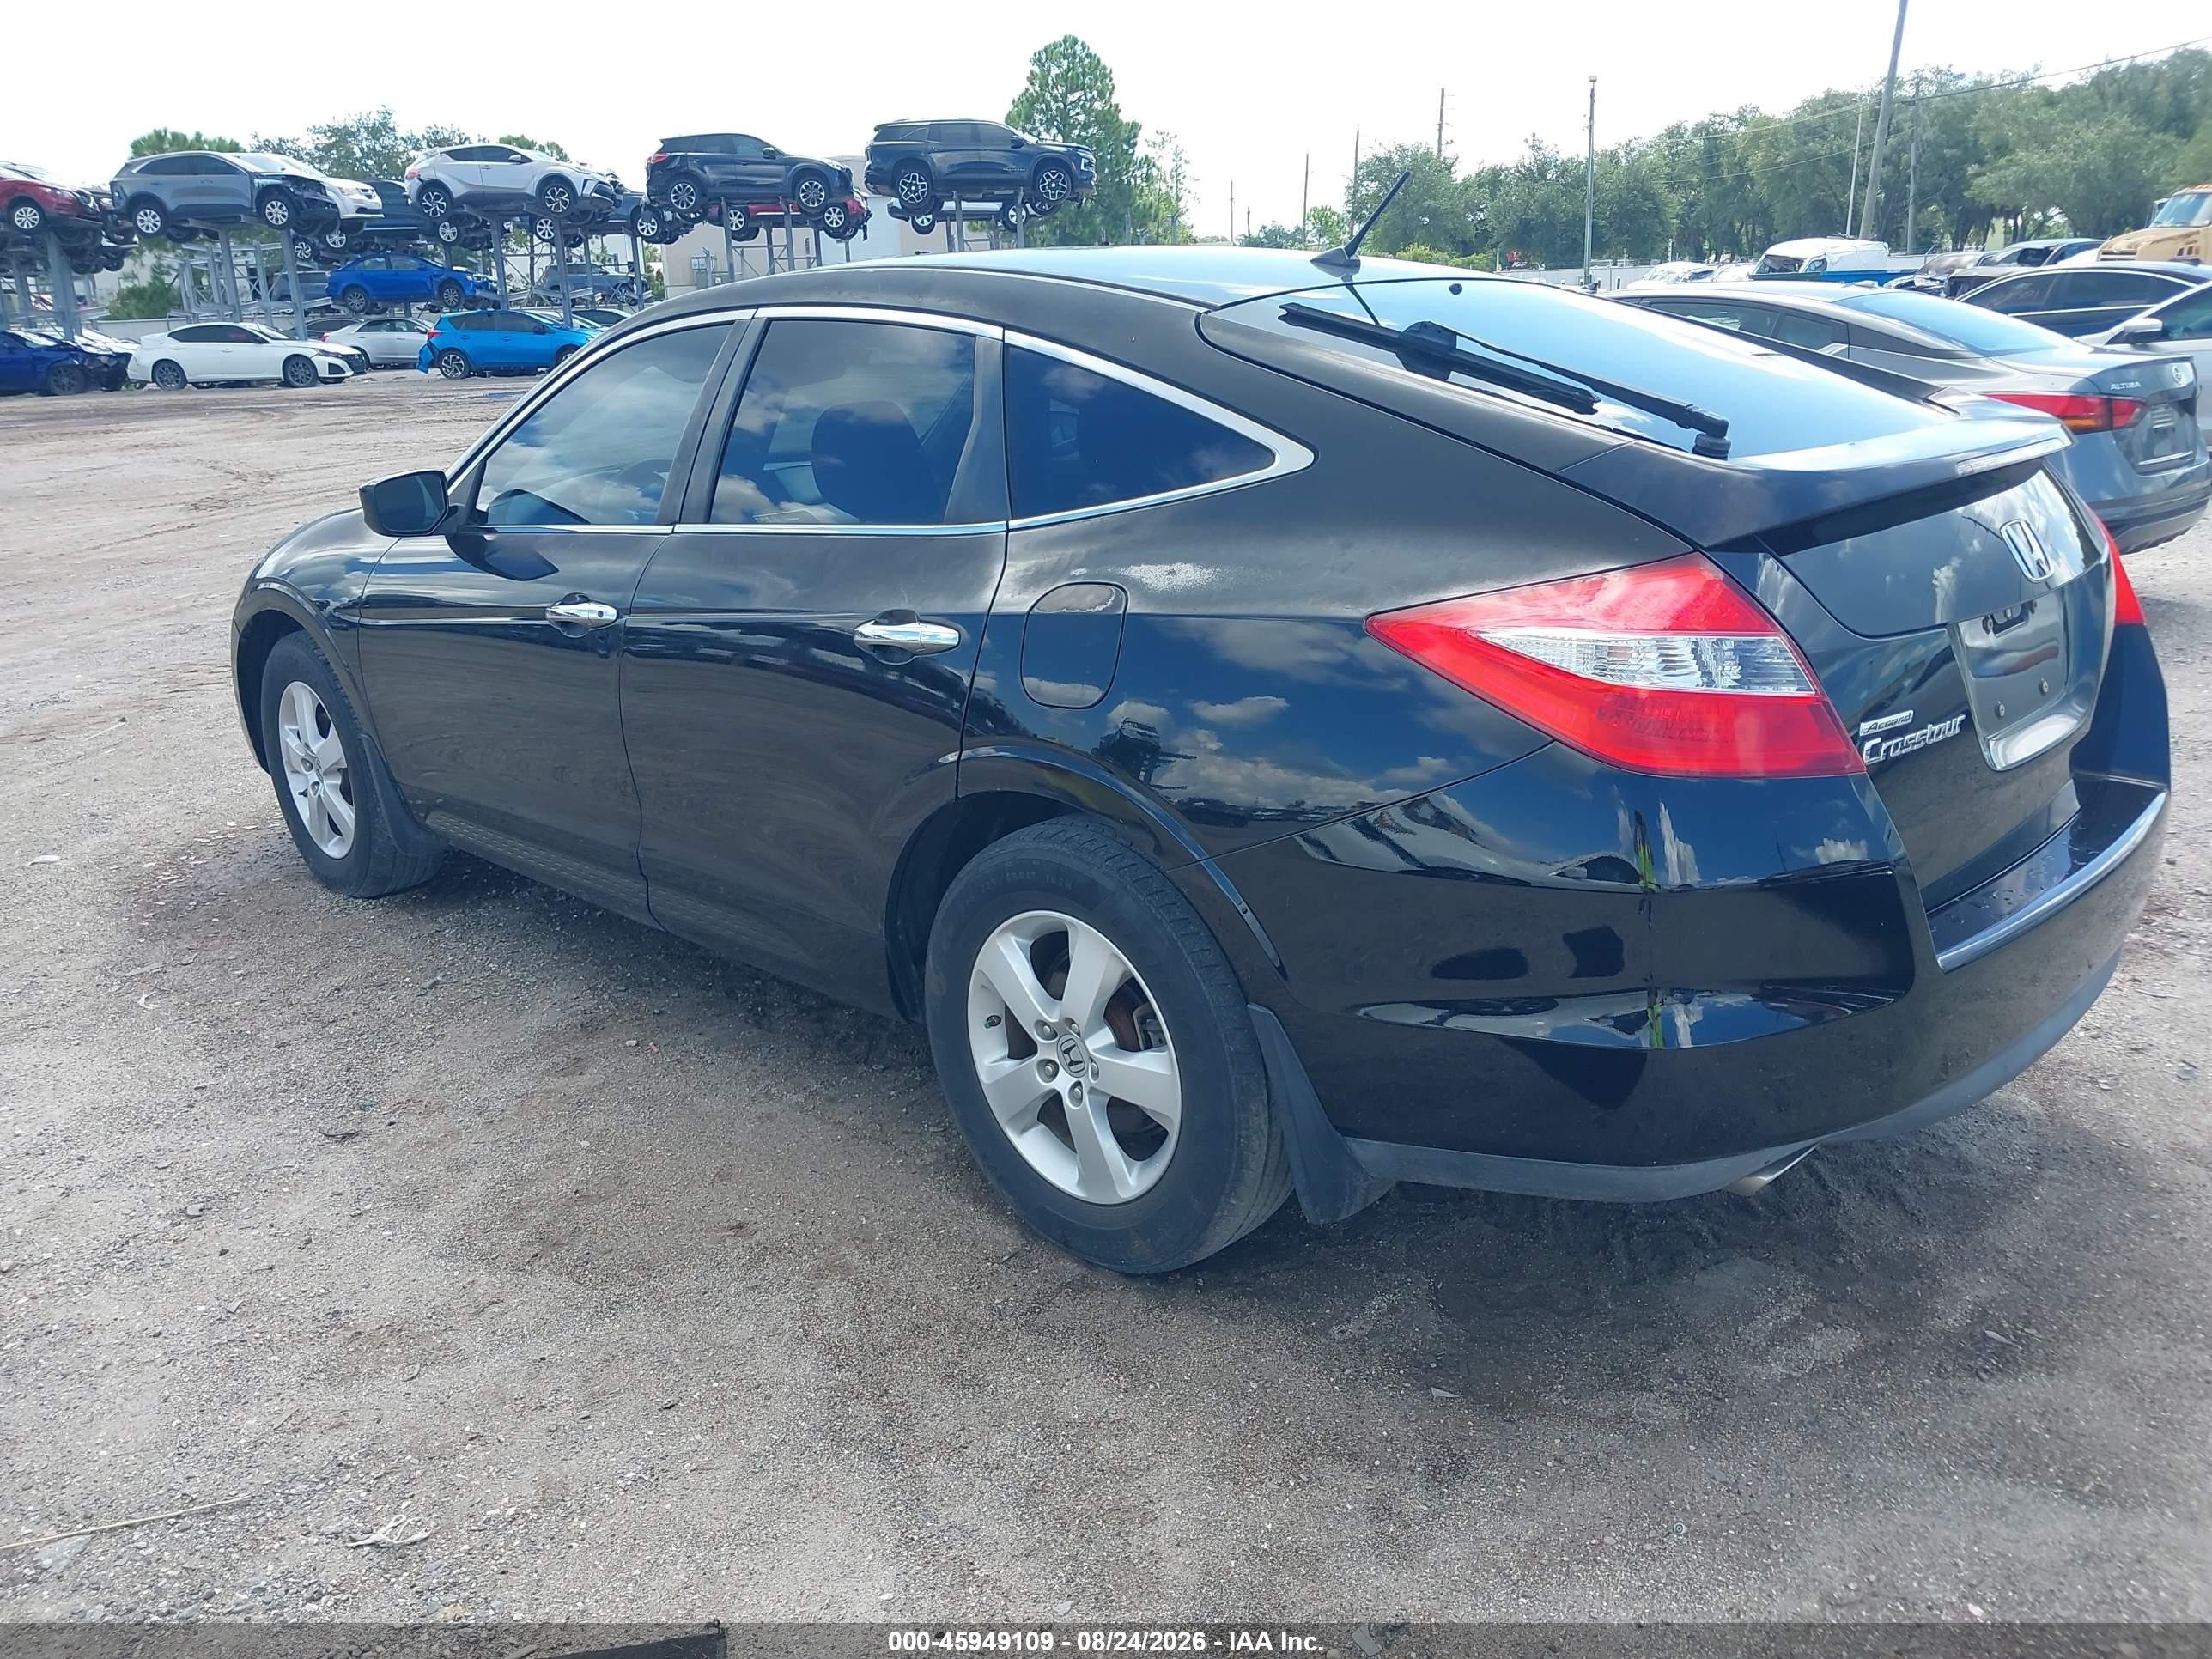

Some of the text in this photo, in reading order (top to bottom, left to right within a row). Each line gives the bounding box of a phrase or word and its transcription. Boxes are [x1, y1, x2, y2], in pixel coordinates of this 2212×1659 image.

[2110, 381, 2142, 391] ALTIMA
[1864, 712, 1913, 733] Accord
[1863, 714, 1966, 765] Crosstour
